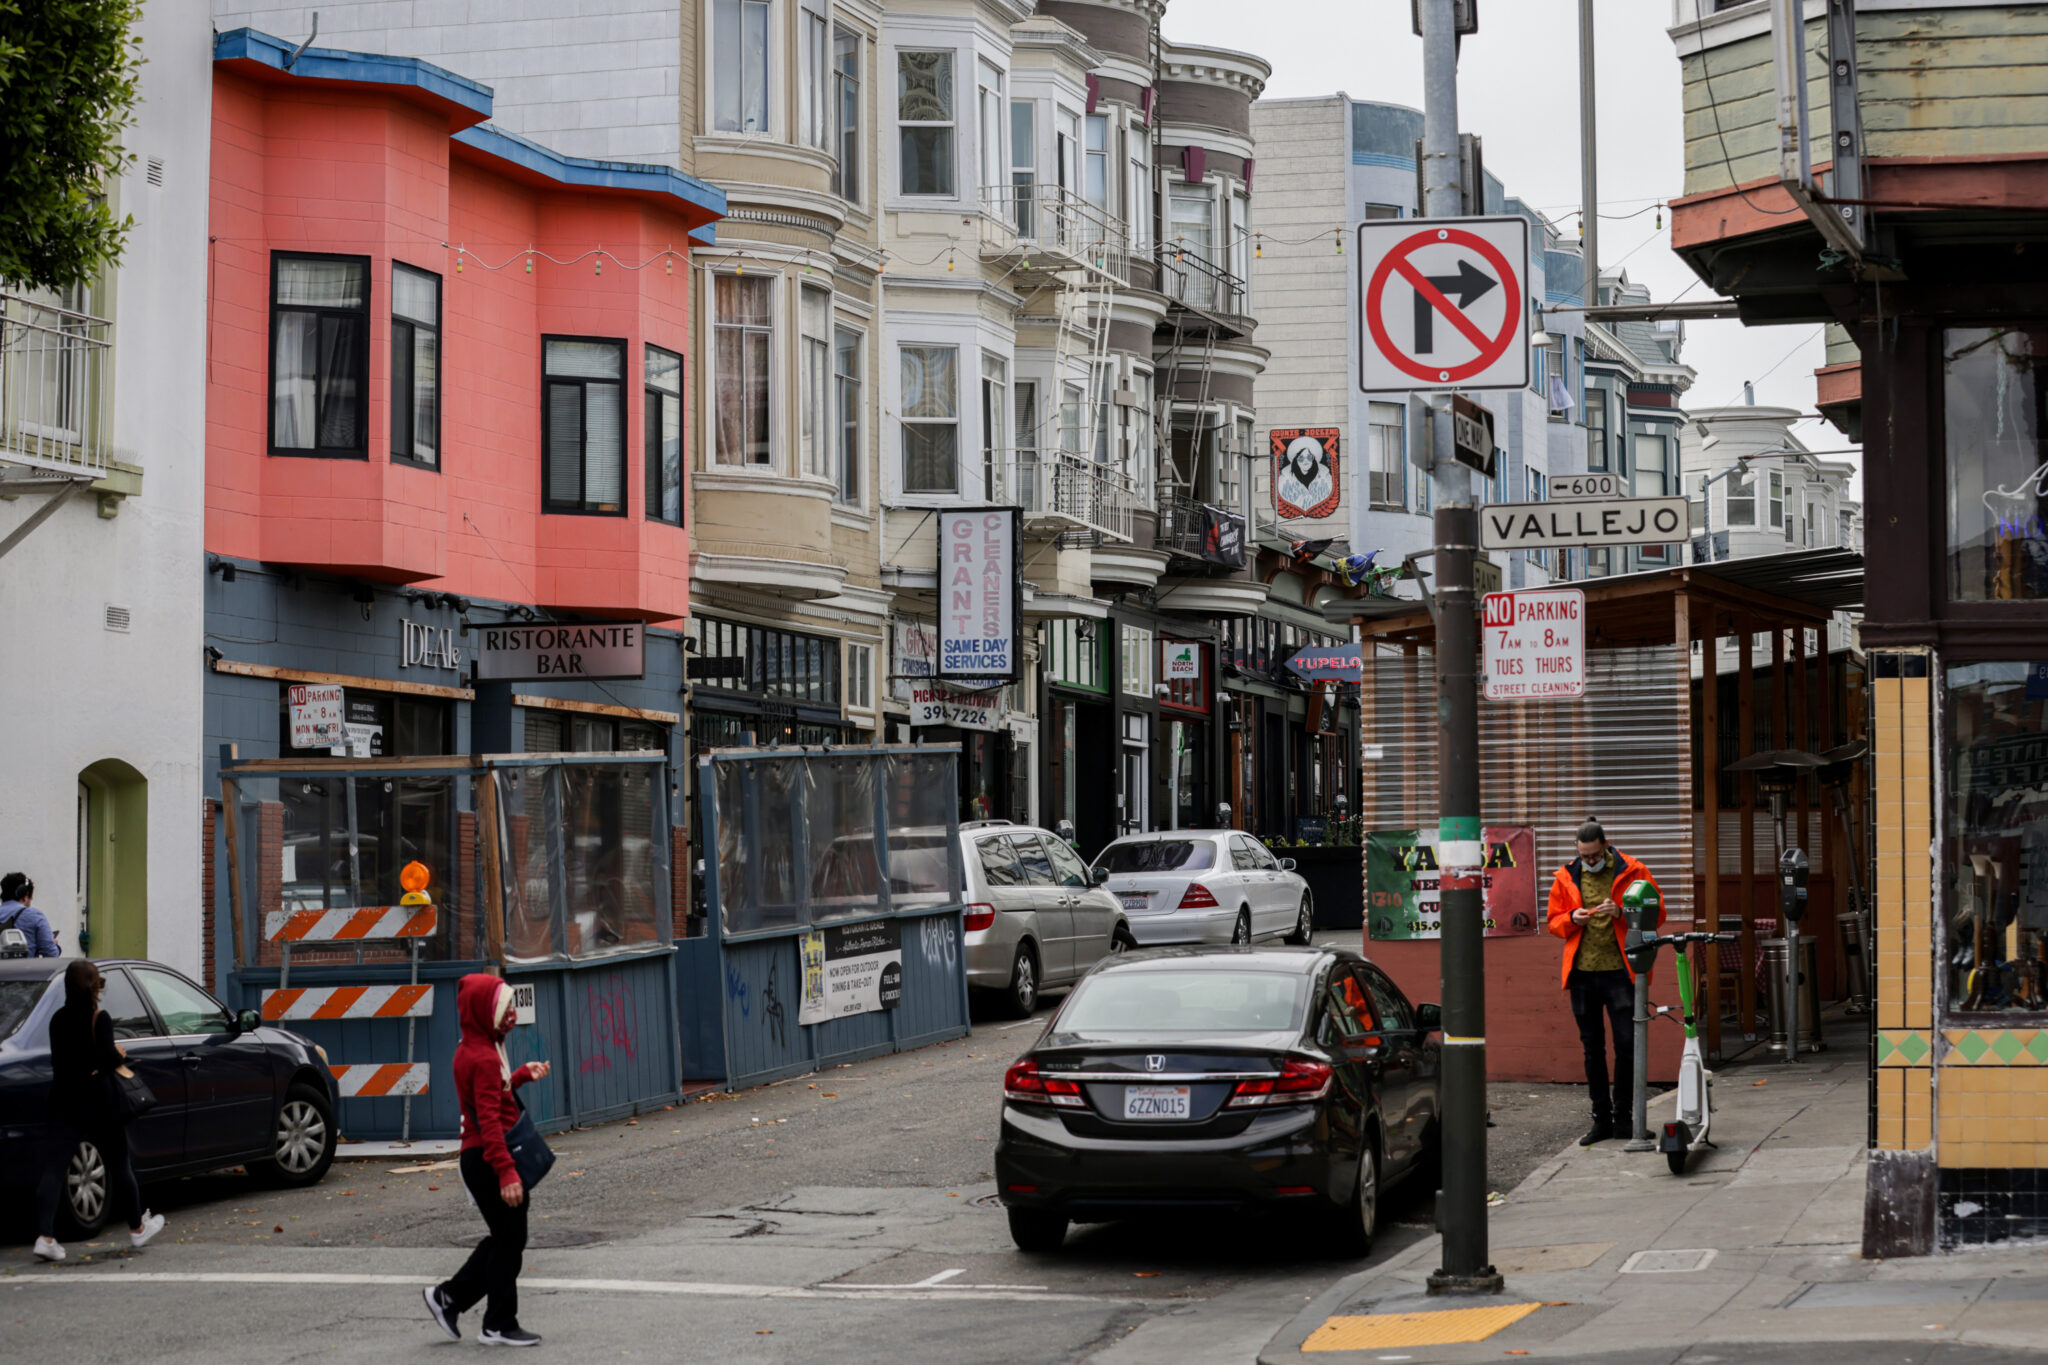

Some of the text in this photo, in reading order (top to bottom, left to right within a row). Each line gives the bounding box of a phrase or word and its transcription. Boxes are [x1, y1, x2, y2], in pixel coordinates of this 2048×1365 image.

[1457, 415, 1484, 452] ONE WAY
[1572, 477, 1611, 494] 600
[1491, 508, 1679, 540] VALLEJO
[951, 518, 973, 635] GRANT
[982, 513, 1002, 638] CLEANERS
[1475, 567, 1497, 592] RANT
[1486, 597, 1578, 623] NO PARKING
[486, 627, 634, 650] RISTORANTE
[905, 627, 937, 657] GRAN
[944, 638, 1008, 654] SAME DAY
[1530, 640, 1538, 648] TO
[537, 653, 583, 674] BAR
[944, 654, 1007, 669] SERVICES
[1294, 656, 1360, 669] TUPELO
[1495, 656, 1573, 675] TUES THURS
[290, 686, 340, 705] NO PARKING
[1492, 681, 1577, 695] STREET CLEANING
[913, 689, 935, 703] PICK
[957, 693, 998, 709] DELIVERY
[923, 706, 987, 724] 398-7226
[295, 725, 311, 734] MON
[327, 723, 339, 733] FRI
[829, 961, 879, 978] NOW OPEN FOR OUTDOOR
[832, 981, 846, 993] DINING
[851, 977, 872, 989] TAKE-OUT
[514, 987, 533, 1008] 1309
[1128, 1098, 1185, 1114] 6ZZN015
